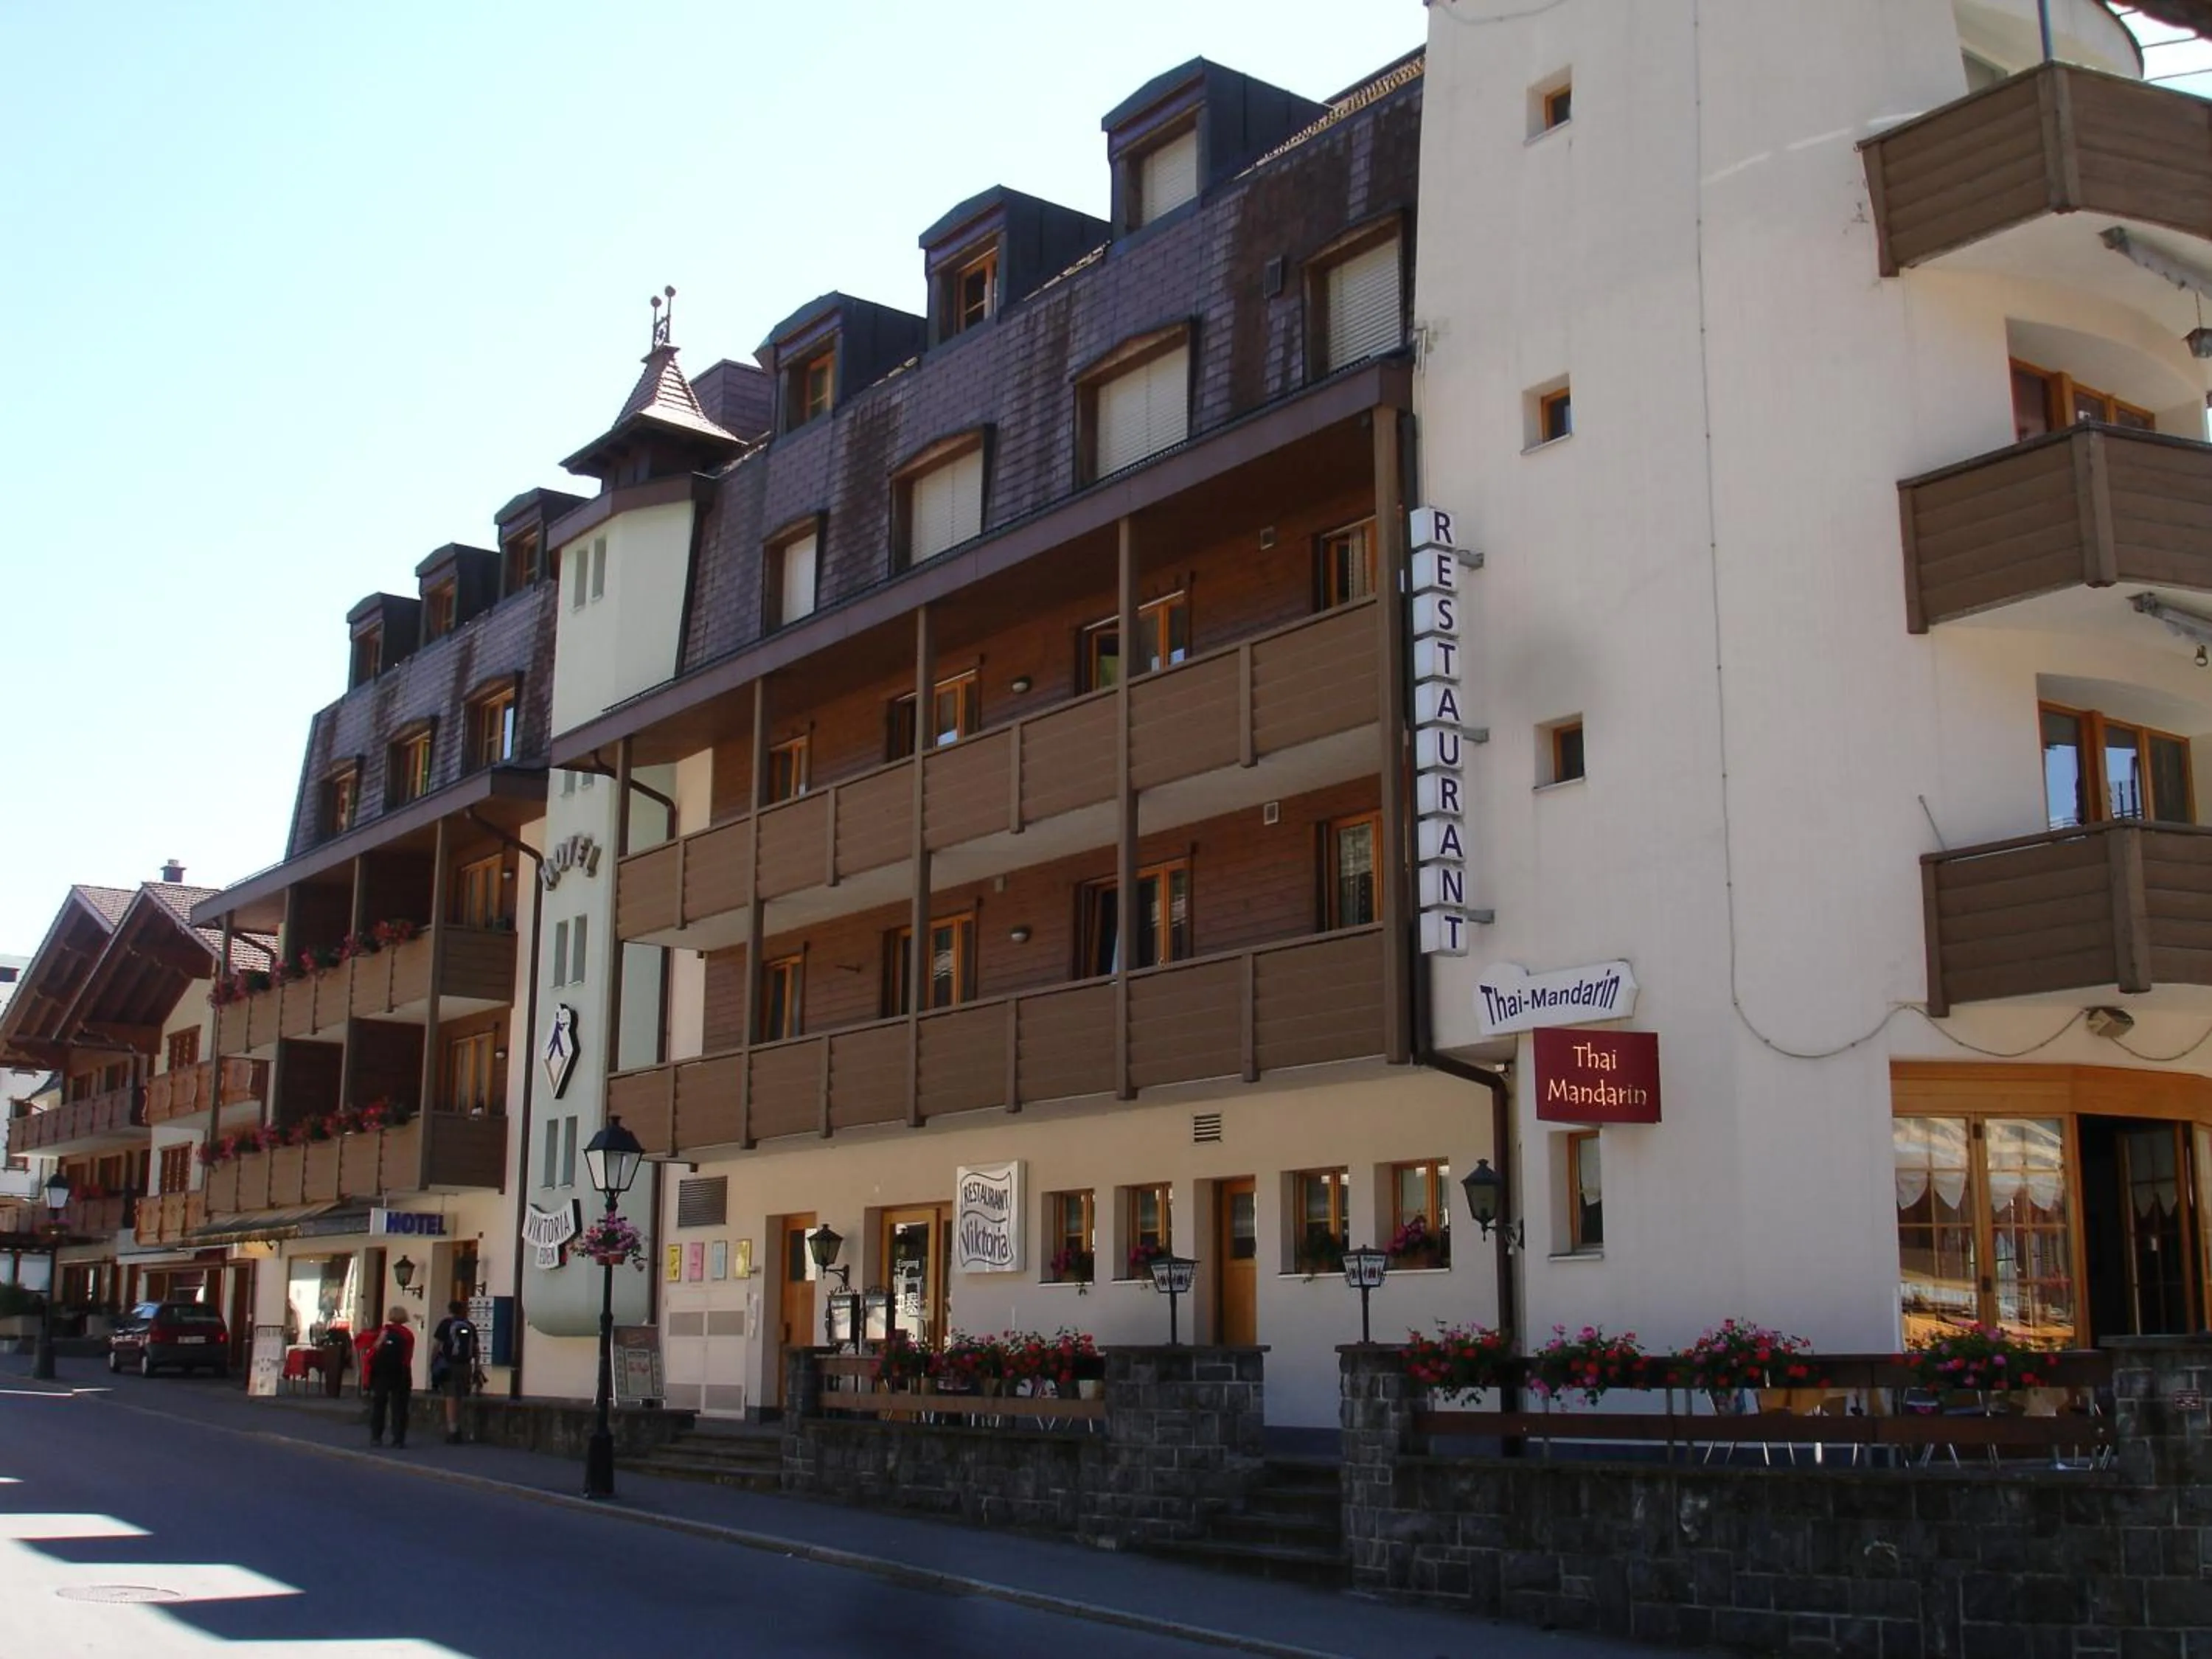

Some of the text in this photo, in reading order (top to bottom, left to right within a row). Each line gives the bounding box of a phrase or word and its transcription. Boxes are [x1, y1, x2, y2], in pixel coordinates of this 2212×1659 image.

[1433, 510, 1464, 950] RESTAURANT
[1480, 968, 1621, 1026] Thai-Mandarin
[1572, 1042, 1617, 1071] Thai
[1547, 1079, 1647, 1106] Mandarin
[963, 1181, 1008, 1210] RESTAURANT
[386, 1211, 447, 1236] HOTEL
[528, 1210, 571, 1245] VIKTORIA
[961, 1218, 1008, 1259] Viktoria
